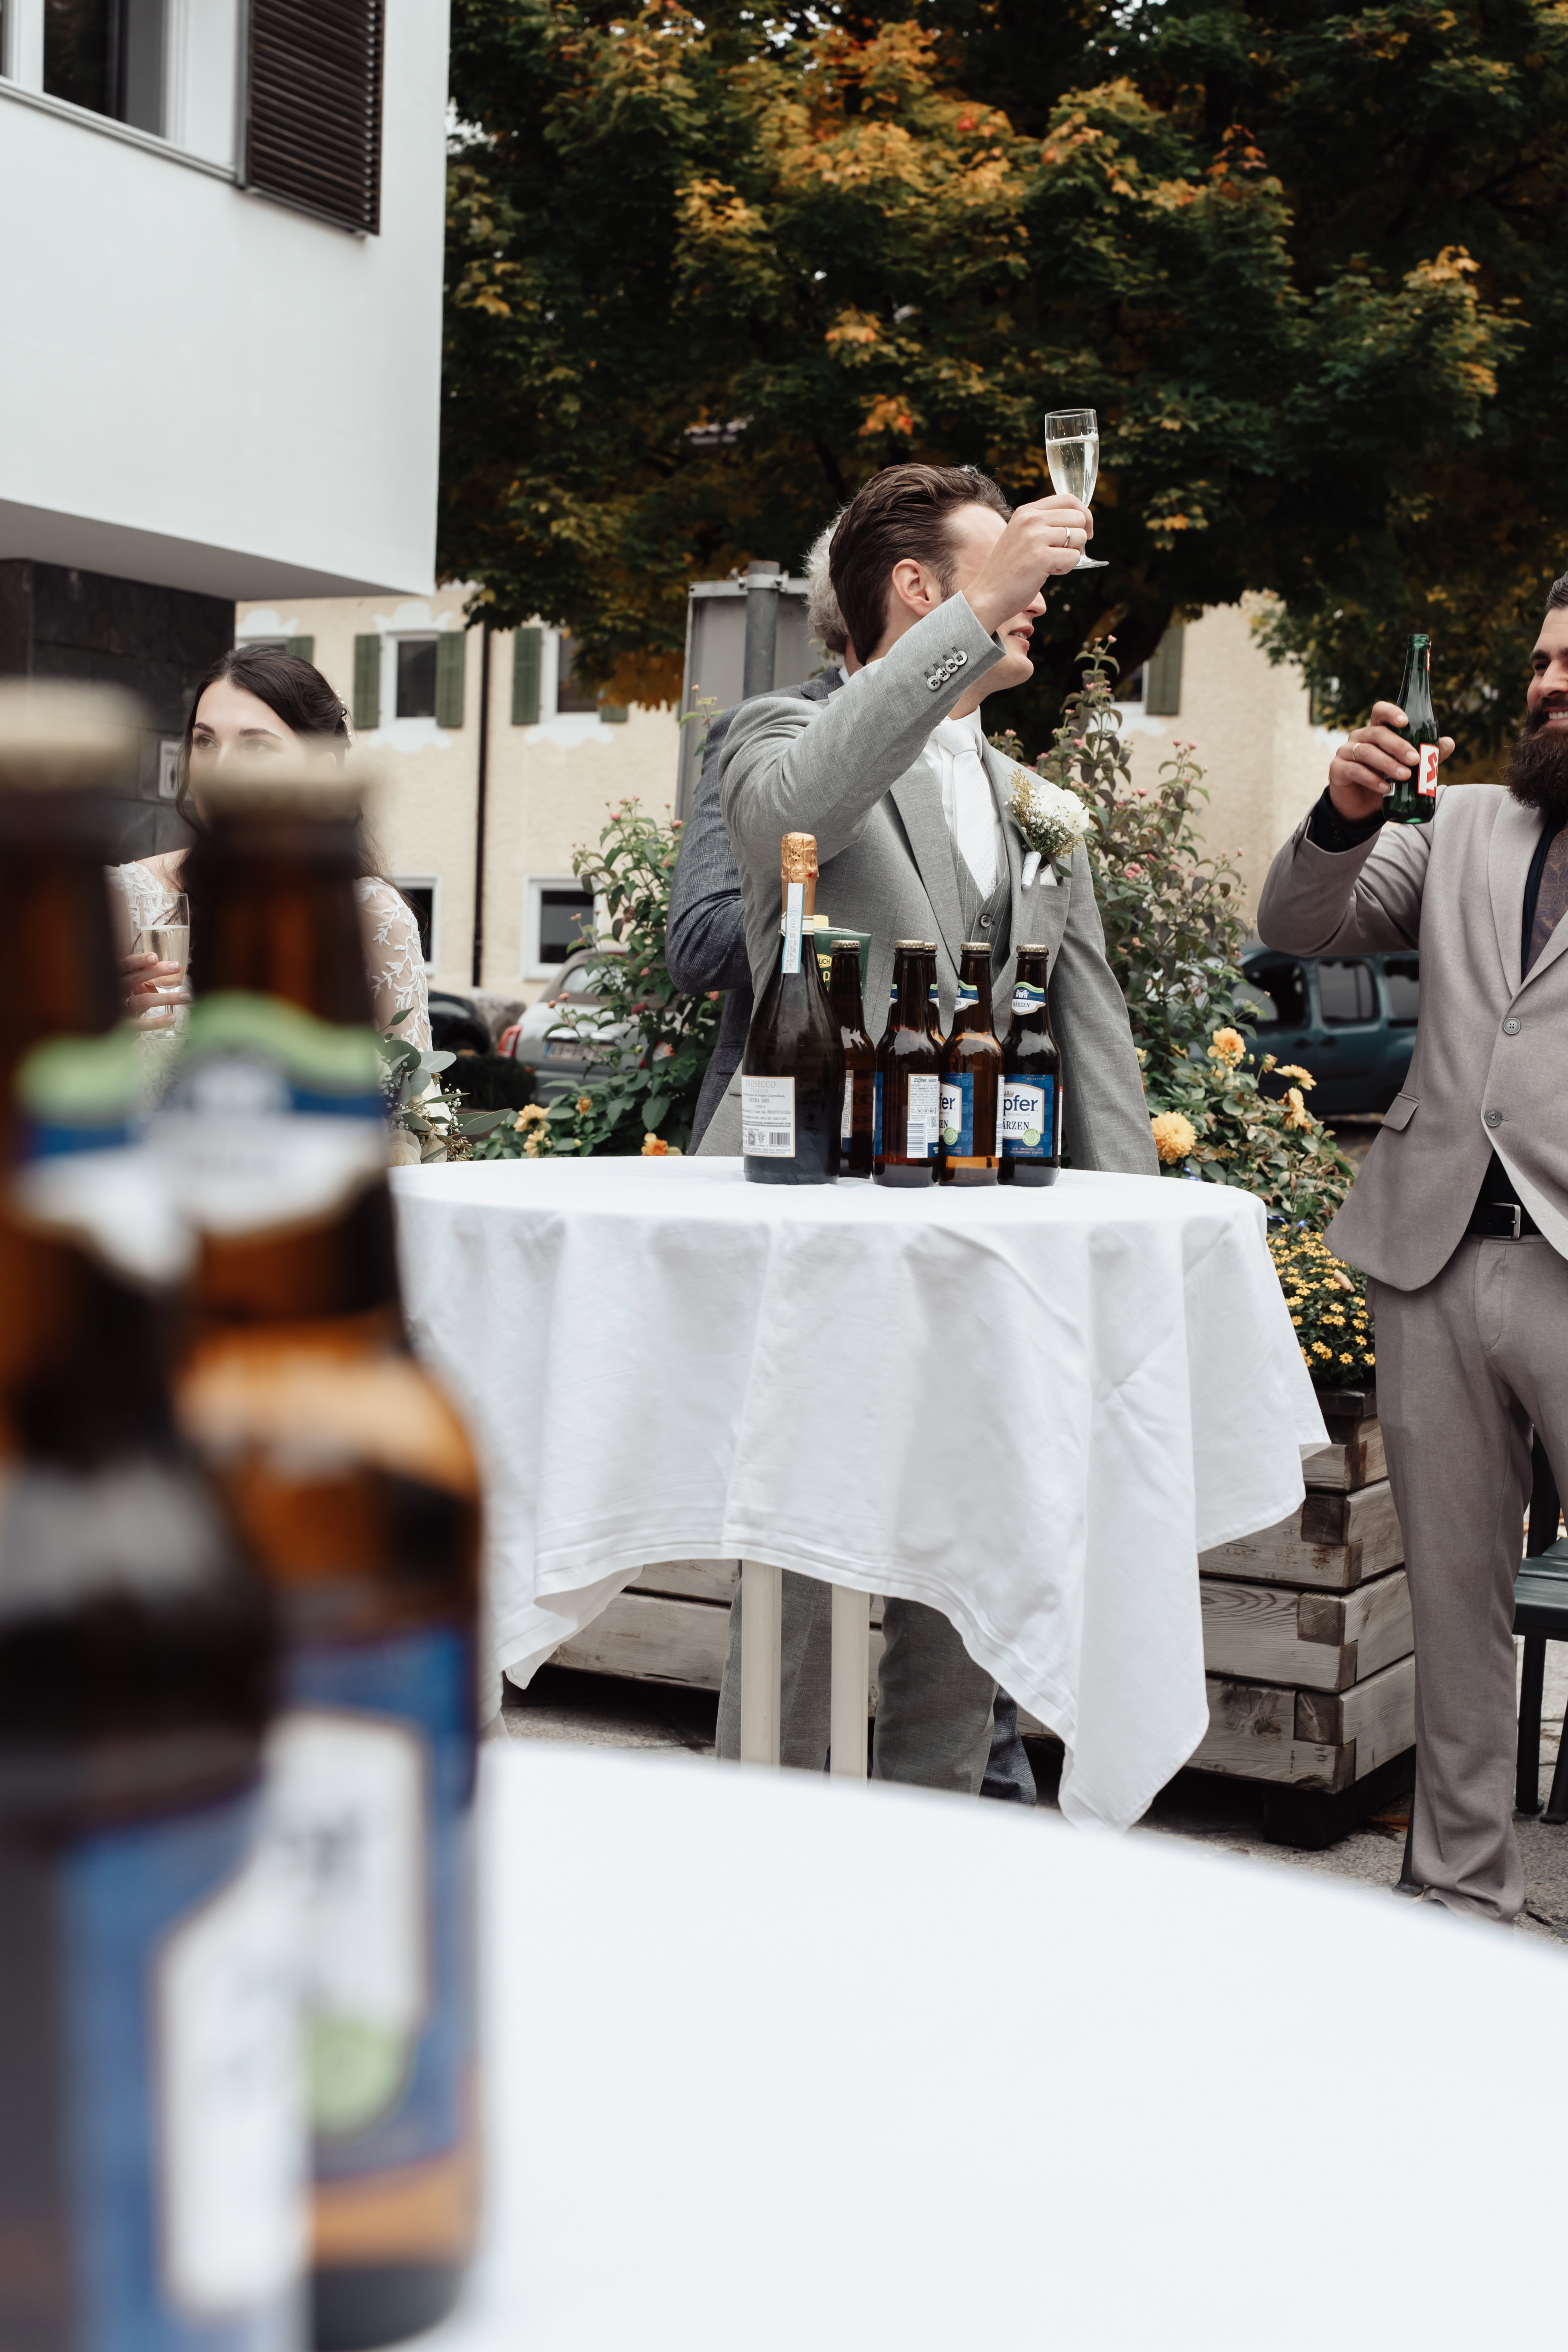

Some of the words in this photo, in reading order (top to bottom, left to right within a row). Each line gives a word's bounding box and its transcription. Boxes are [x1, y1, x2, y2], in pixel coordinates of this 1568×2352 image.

[746, 1080, 776, 1088] PROSECCO
[939, 1092, 956, 1110] fer
[1003, 1095, 1038, 1116] pfer
[1003, 1119, 1029, 1130] ÄRZEN
